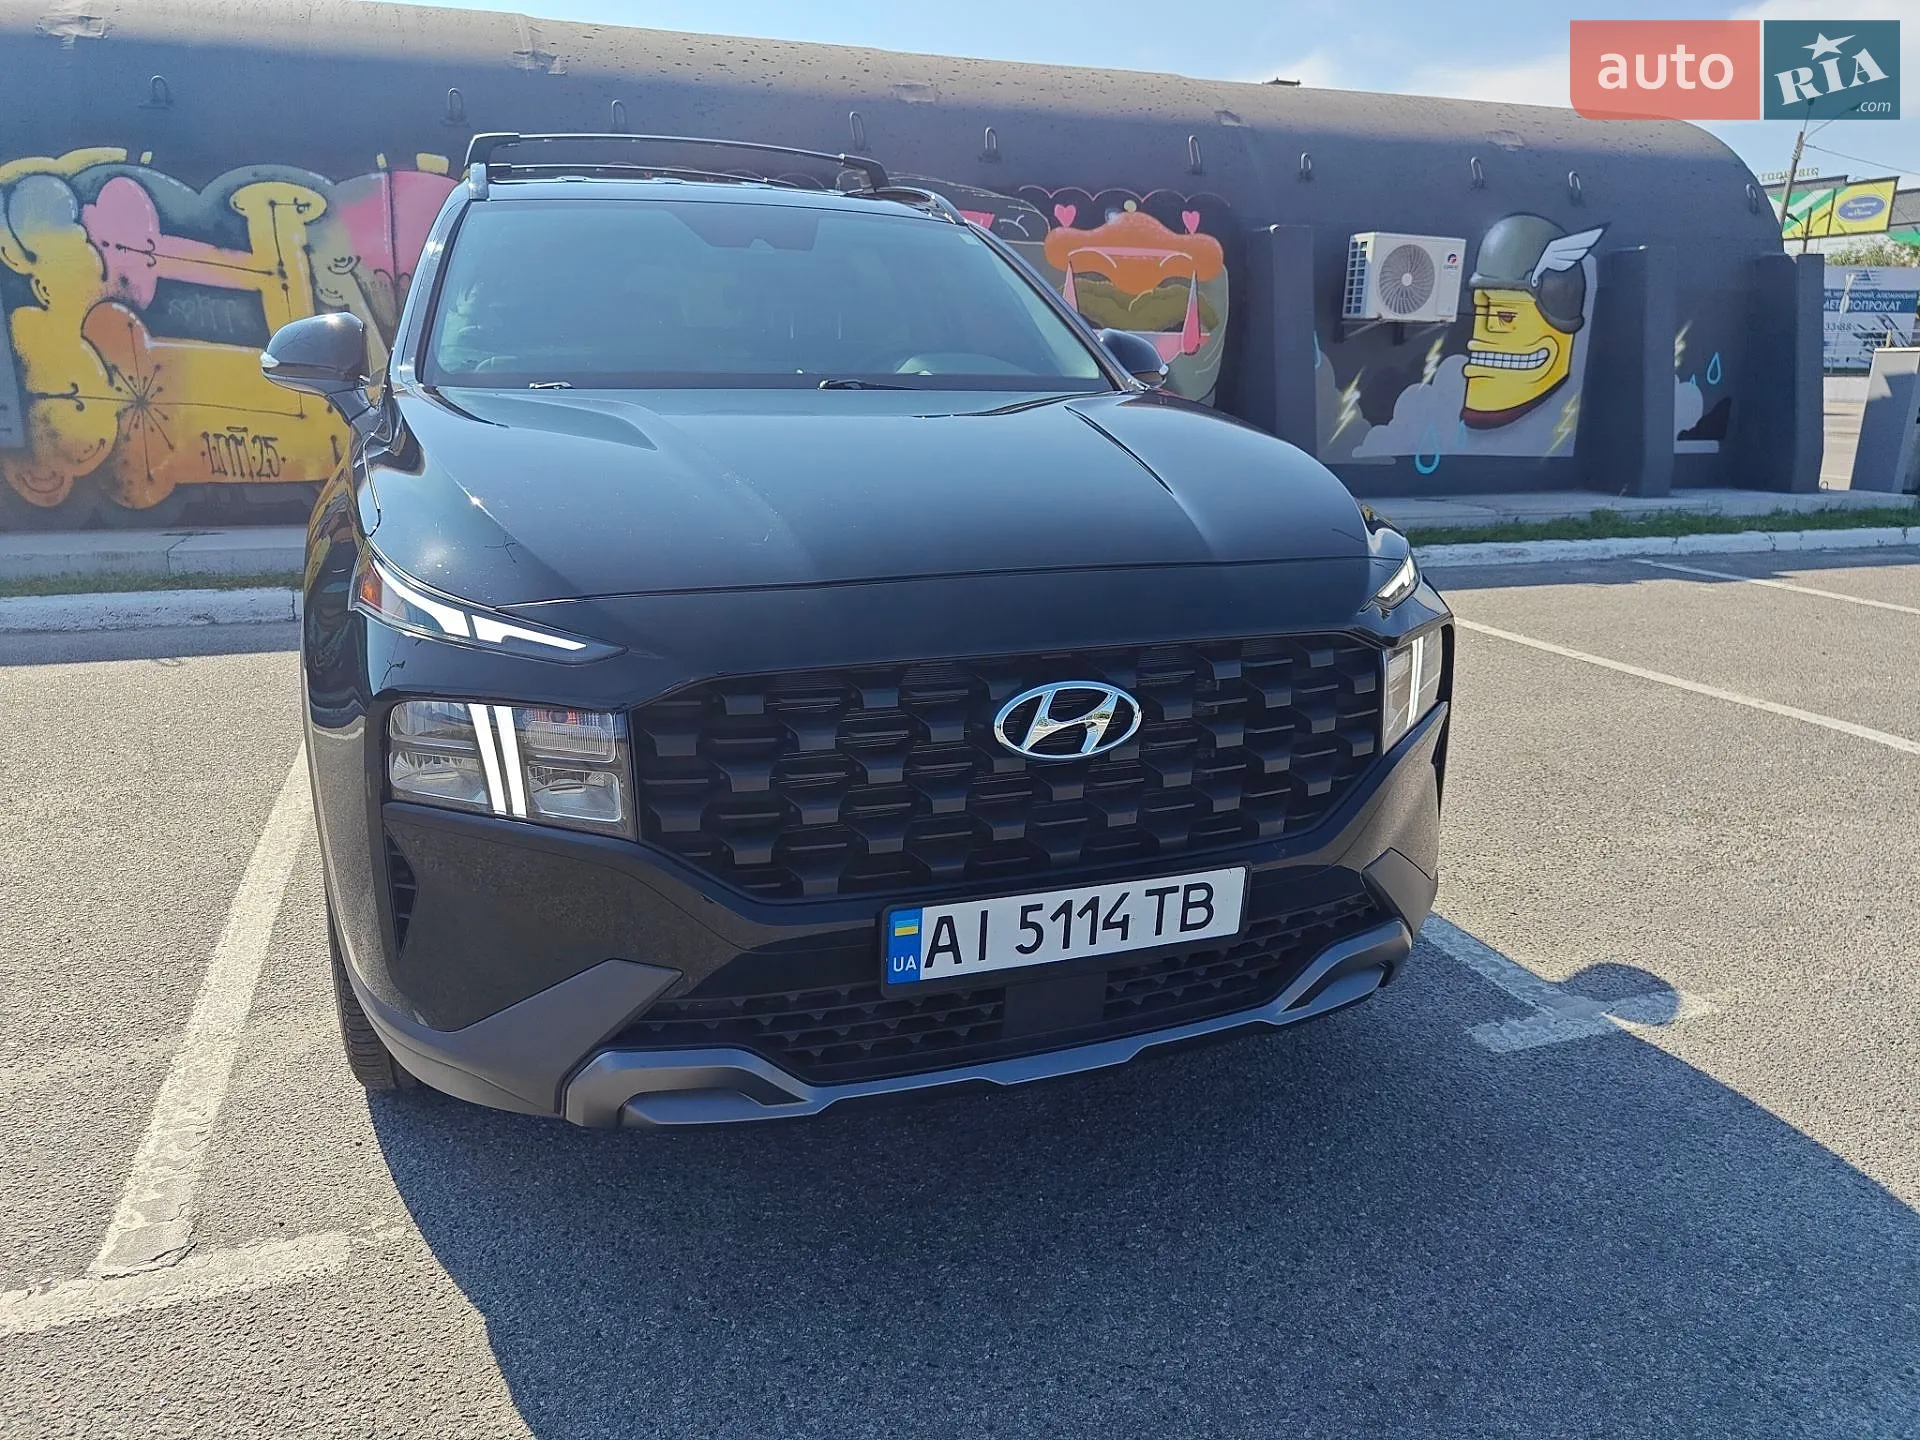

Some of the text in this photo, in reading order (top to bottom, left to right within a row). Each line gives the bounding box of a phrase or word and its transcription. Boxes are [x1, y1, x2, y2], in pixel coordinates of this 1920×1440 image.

[924, 881, 1215, 969] AI 5114 TB
[893, 954, 917, 973] UA
